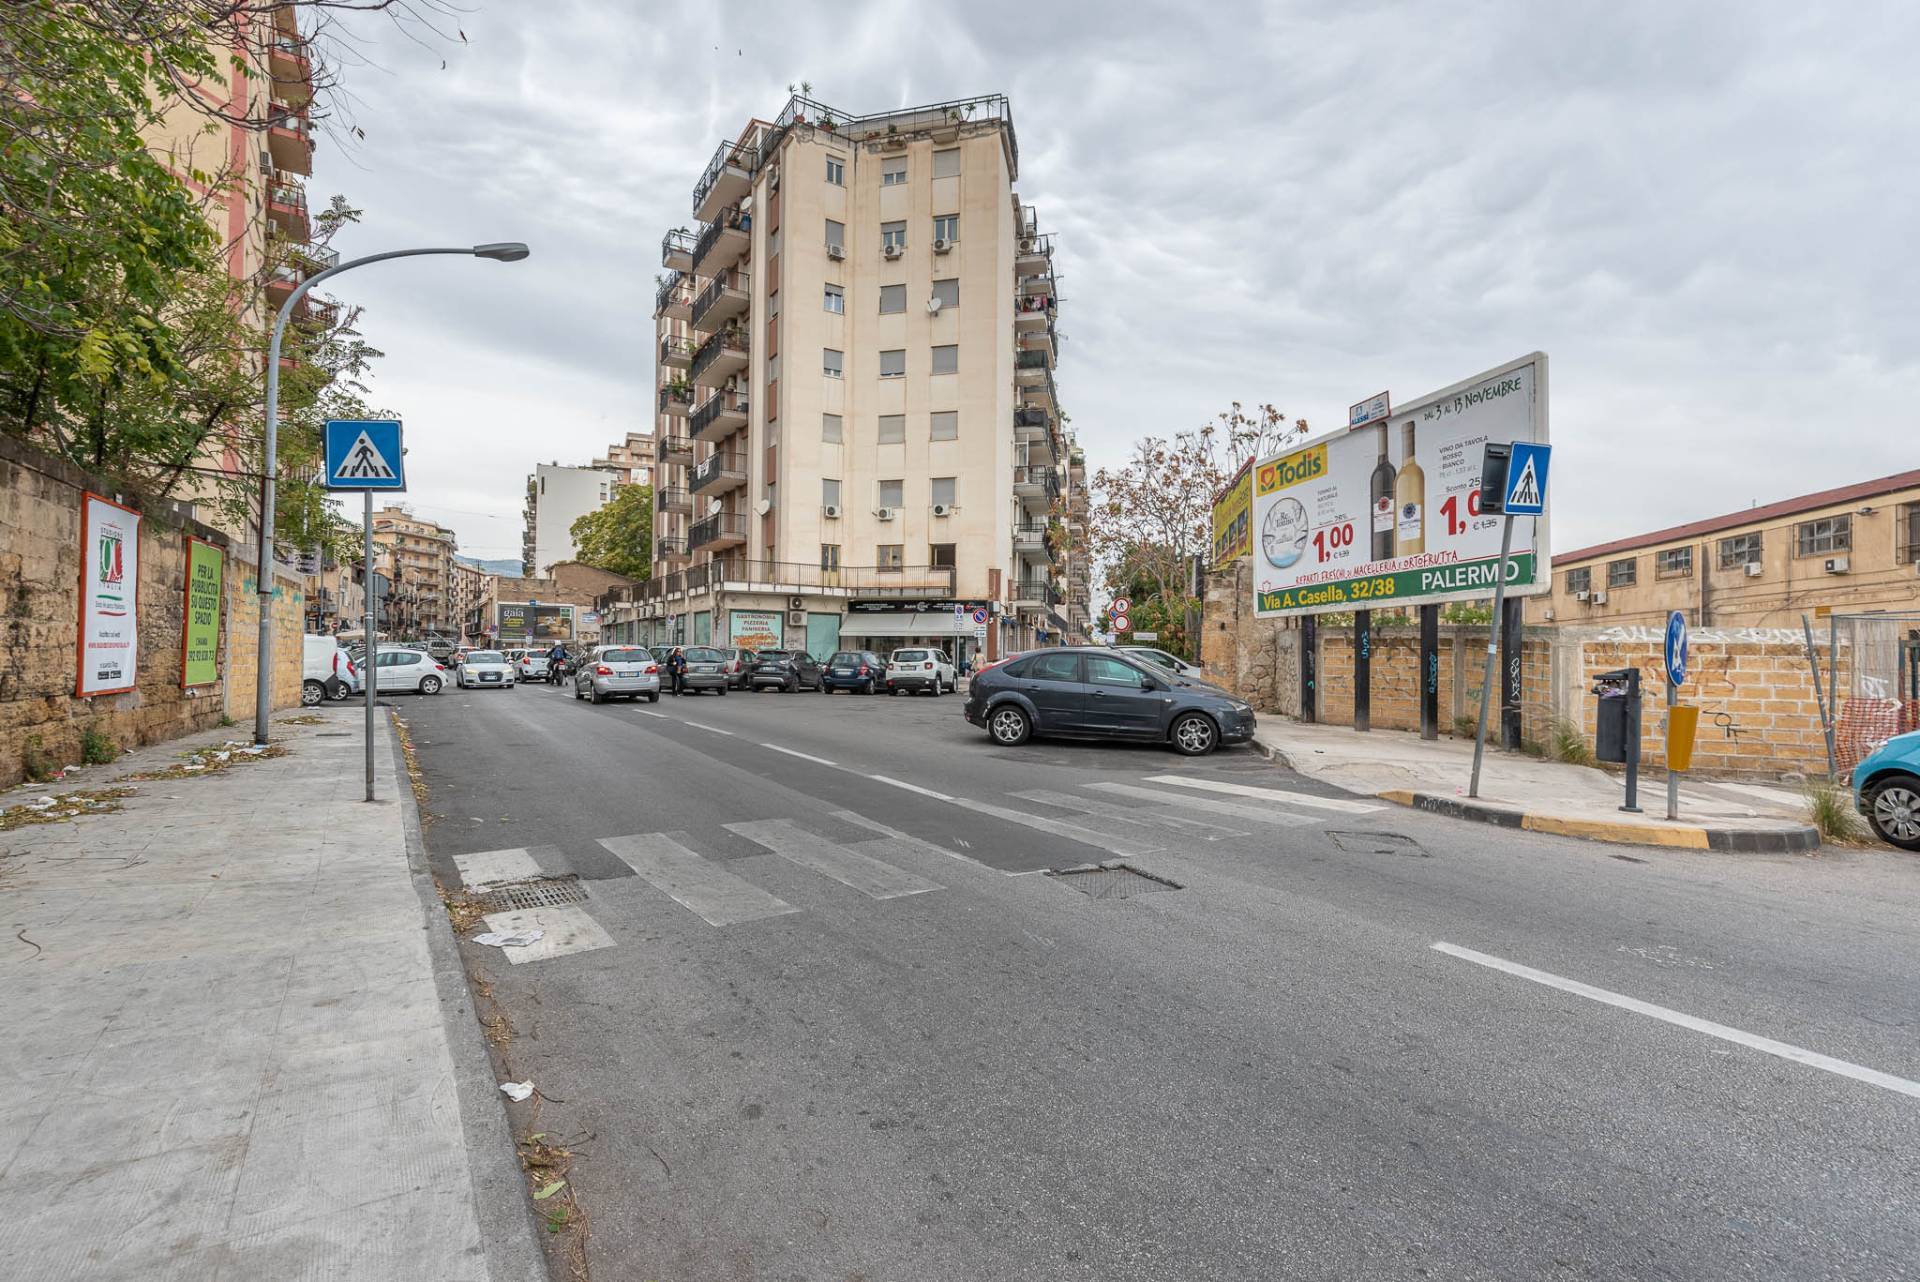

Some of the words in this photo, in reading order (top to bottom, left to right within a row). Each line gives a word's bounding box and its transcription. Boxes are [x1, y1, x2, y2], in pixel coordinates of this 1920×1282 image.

[1435, 405, 1442, 420] 3
[1454, 397, 1462, 414] 13
[1465, 377, 1521, 409] NOVEMBRE
[1439, 444, 1454, 454] VINO
[1455, 441, 1464, 450] DA
[1464, 435, 1488, 447] TAVOLA
[1442, 451, 1463, 461] ROSSO
[1276, 453, 1321, 486] Todis
[1442, 459, 1465, 469] BIANCO
[1445, 483, 1467, 493] Sconto
[1468, 477, 1481, 487] 25
[1440, 489, 1481, 536] 1,0
[1312, 523, 1354, 563] 1,00
[197, 564, 208, 578] PER
[208, 567, 214, 579] LA
[1295, 573, 1319, 585] REPARTI
[1321, 567, 1345, 581] FRESCHI
[1353, 561, 1397, 578] MACELLERIA
[1404, 550, 1458, 569] ORTOFRUTTA
[1421, 561, 1519, 590] PALERMO
[191, 595, 199, 609] SU
[199, 595, 217, 610] QUESTO
[1264, 595, 1281, 610] Via
[1283, 592, 1296, 607] A.
[1298, 586, 1347, 605] Casella,
[1351, 577, 1395, 597] 32/38
[194, 611, 212, 625] SPAZIO
